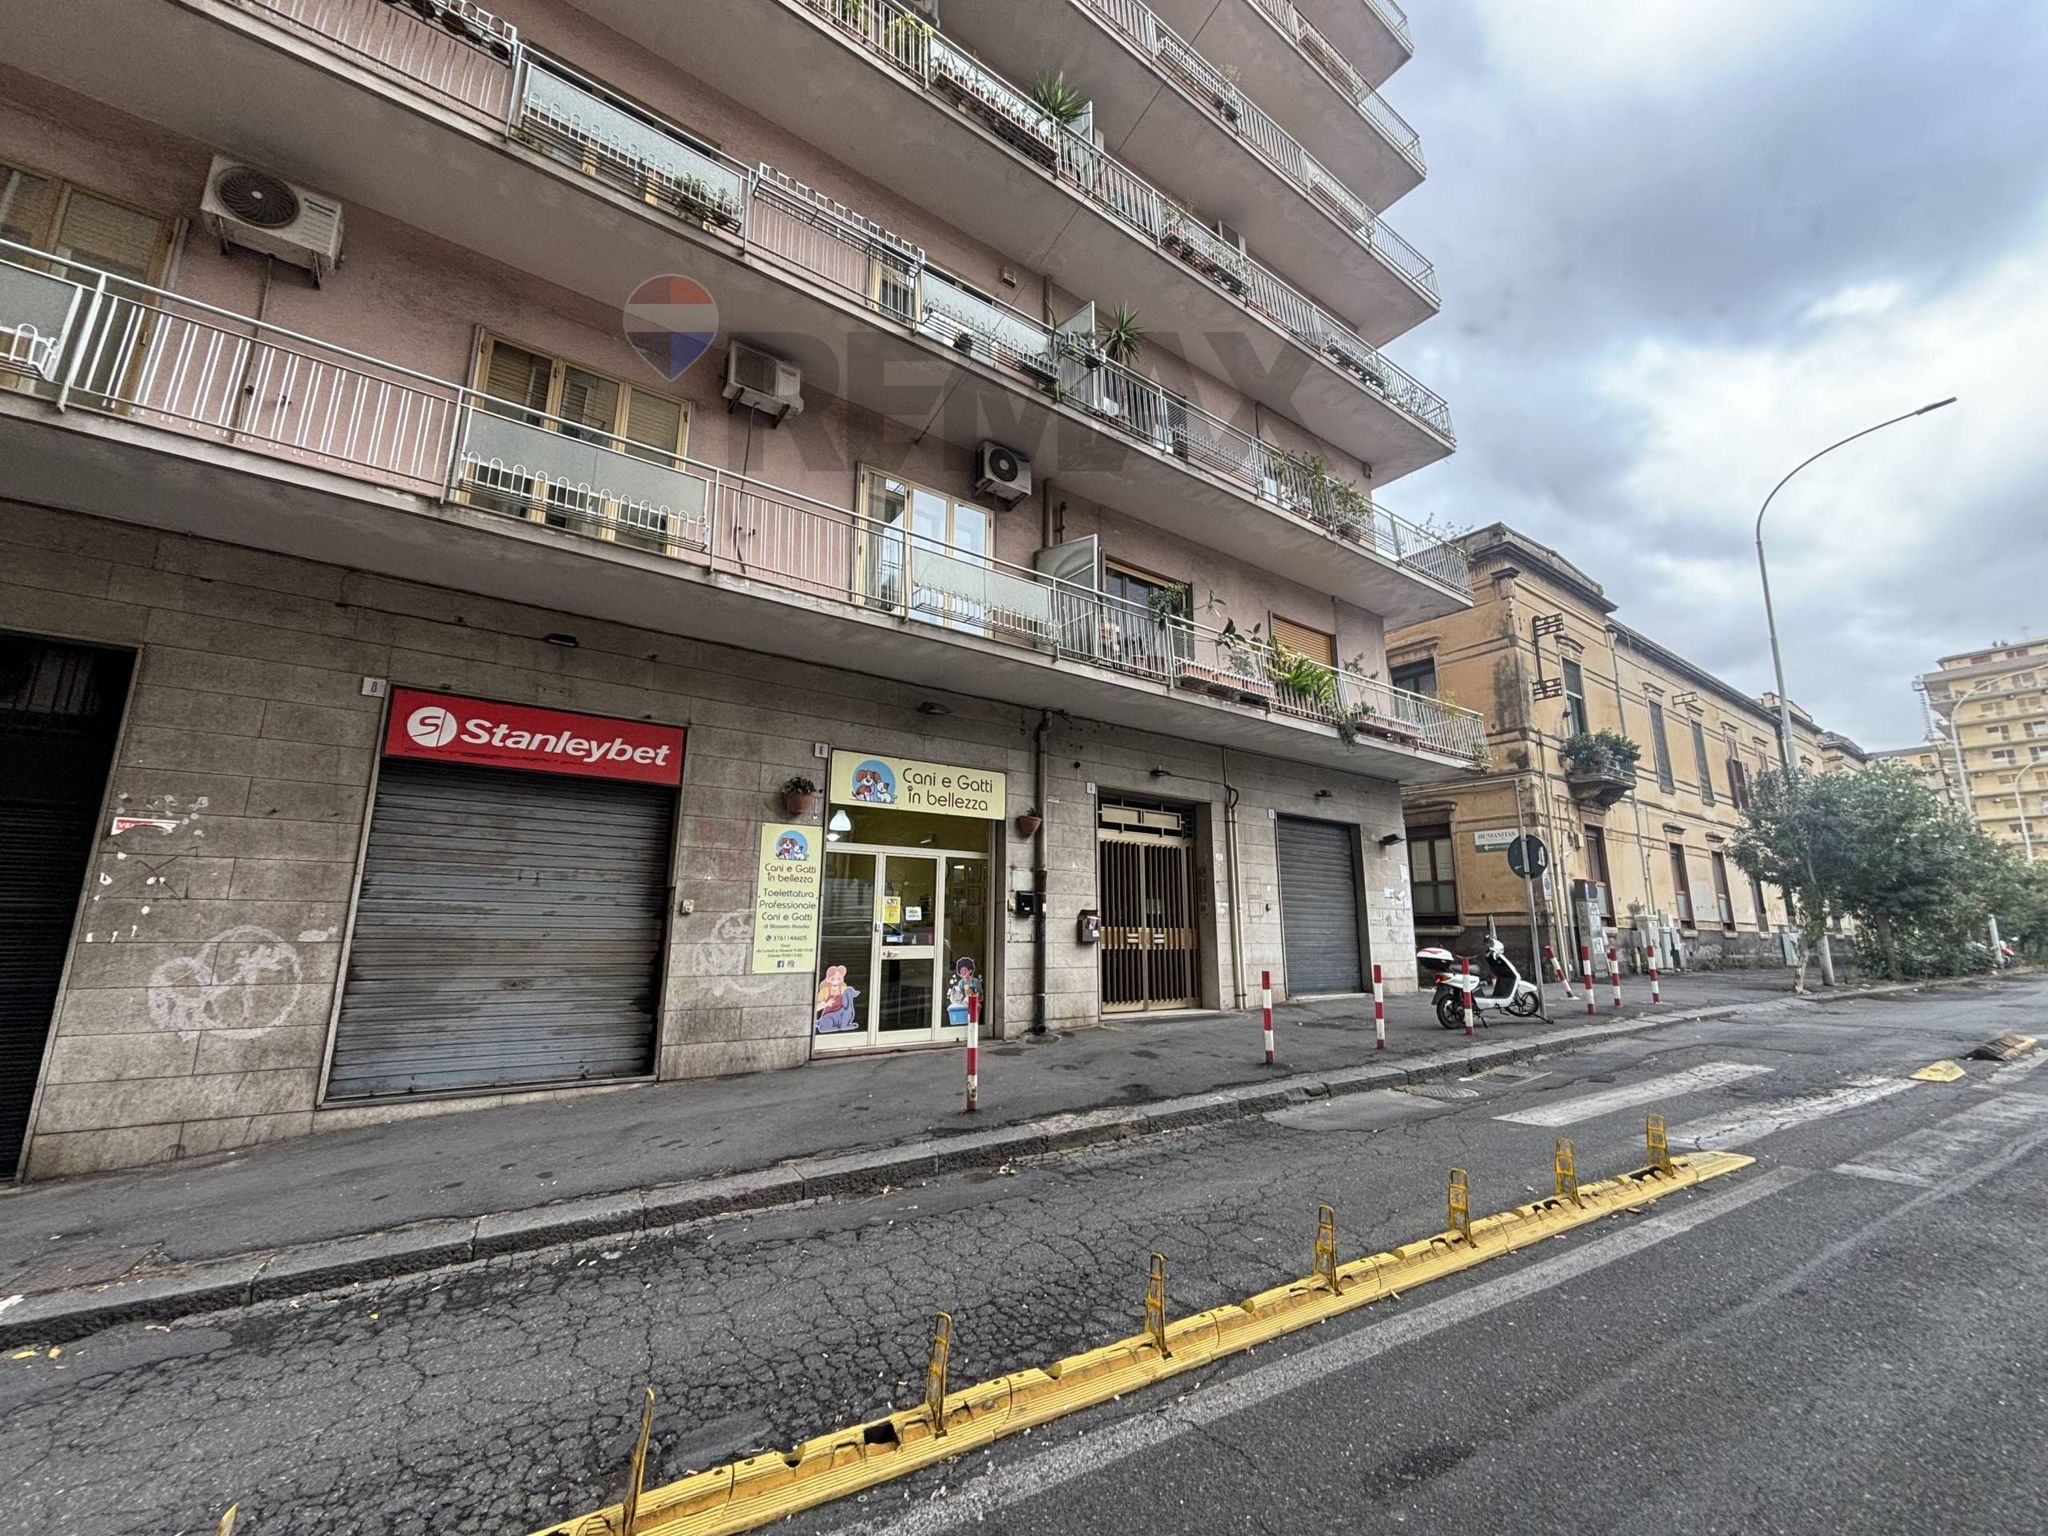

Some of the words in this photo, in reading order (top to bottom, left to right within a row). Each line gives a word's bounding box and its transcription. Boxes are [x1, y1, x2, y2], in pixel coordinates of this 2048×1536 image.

[460, 718, 670, 766] Stanleybet
[902, 767, 936, 787] Cani
[941, 777, 952, 788] e
[957, 774, 993, 793] Gatti
[907, 785, 921, 804] in
[926, 789, 988, 811] bellezza
[764, 862, 784, 872] Cani
[795, 864, 817, 874] Gatti
[767, 872, 775, 882] in
[777, 873, 814, 884] bellezza
[763, 887, 815, 898] Toelettatura
[759, 899, 817, 910] Professionale
[761, 911, 781, 920] Cani
[791, 912, 813, 921] Gatti
